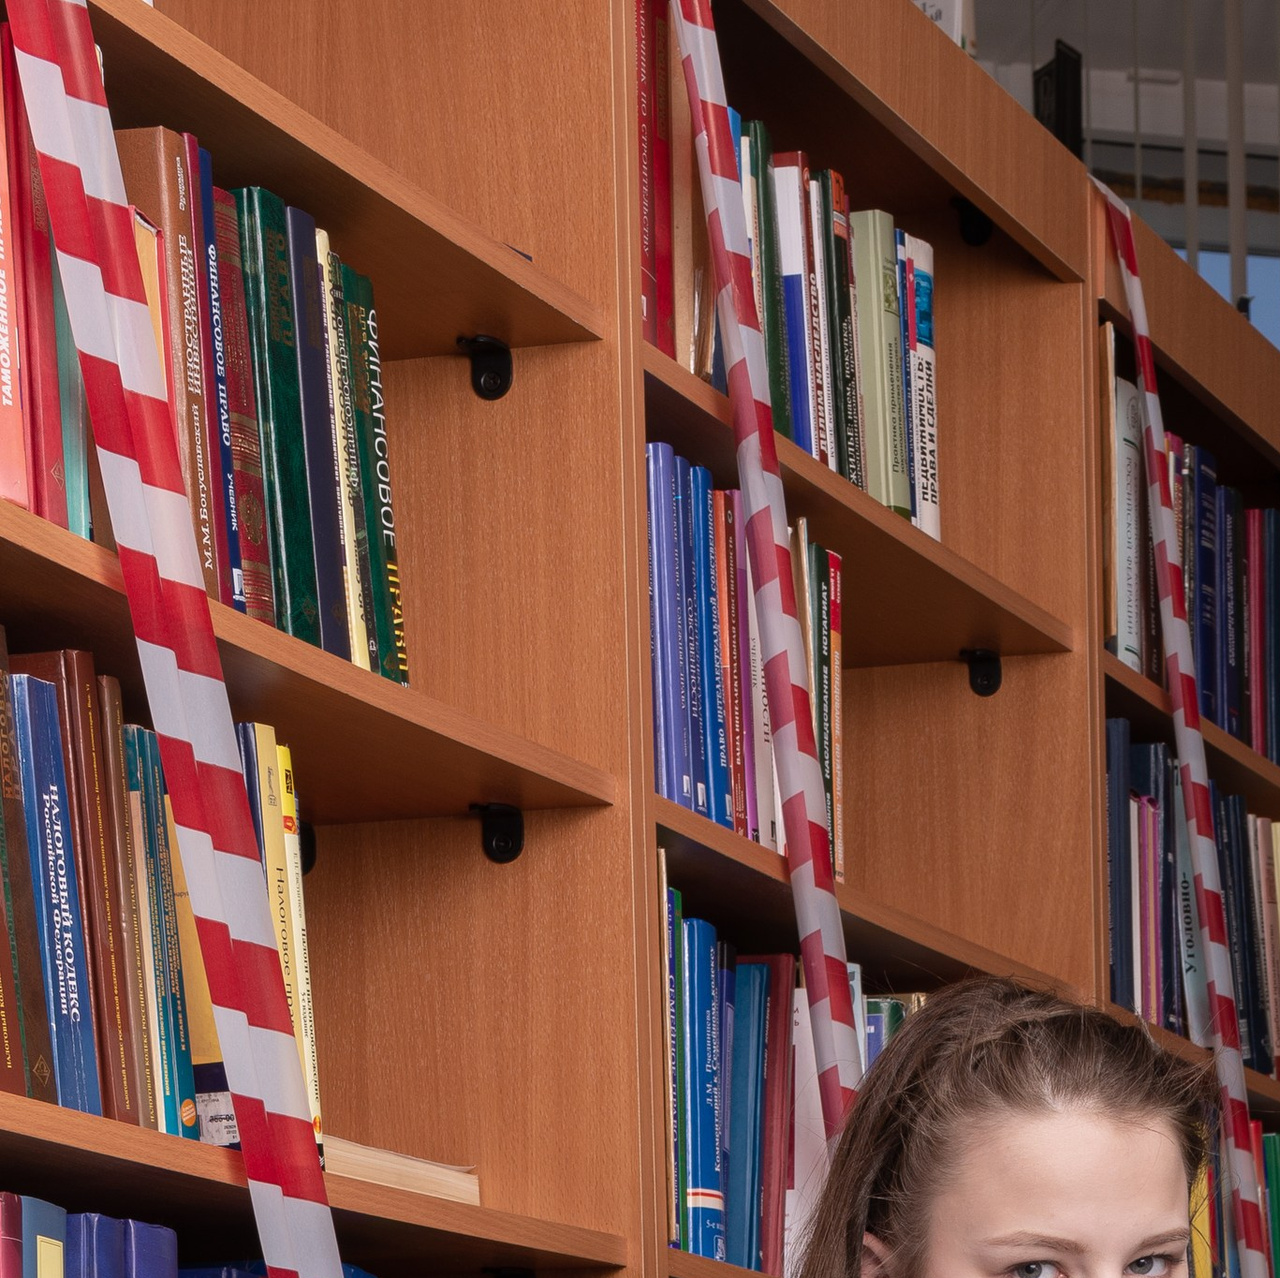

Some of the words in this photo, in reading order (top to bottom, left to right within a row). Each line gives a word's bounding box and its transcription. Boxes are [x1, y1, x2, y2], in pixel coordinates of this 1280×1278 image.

[179, 234, 197, 392] ИНОСТРАННЫЕ
[184, 248, 202, 396] ИНВЕСТИЦИИ
[277, 233, 294, 348] ПРАВО
[809, 273, 824, 385] НАСЛЕДСТВО
[208, 244, 225, 376] ФИНАНСОВОЕ
[217, 383, 231, 446] ПРАВО
[888, 342, 897, 414] применения
[367, 309, 396, 547] ФИНАНСОВОЕ
[815, 390, 827, 452] ДЕЛИМ
[925, 360, 936, 428] СДЕЛКИ
[890, 416, 899, 473] Практика
[927, 432, 936, 443] И
[927, 446, 938, 506] ПРАВА
[227, 474, 239, 531] УЧЕБНИК
[706, 488, 718, 592] СОБСТВЕННОСТИ
[687, 597, 698, 718] СОБСТВЕННОСТИ
[821, 582, 829, 655] НОТАРИАТ
[710, 597, 725, 722] ИНТЕЛЛЕКТУАЛЬНОЙ
[716, 728, 727, 767] ПРАВО
[821, 664, 830, 779] НАСЛЕДОВАНИЕ
[43, 792, 61, 905] Российской
[49, 784, 72, 927] НАЛОГОВЫЙ
[61, 931, 81, 1023] КОДЕКС
[275, 867, 291, 976] Налоговое
[1180, 872, 1197, 973] Уголовно-
[51, 909, 69, 1015] Федерации
[301, 928, 309, 970] Налоги
[137, 970, 149, 1030] РОССИЙСКОЙ
[710, 1000, 720, 1073] Семейному
[142, 1032, 152, 1066] КОДЕКС
[705, 1010, 713, 1073] Пчелинцева
[145, 1067, 156, 1123] НАЛОГОВЫЙ
[706, 1081, 714, 1107] Л.М.
[712, 1087, 721, 1173] Комментарий
